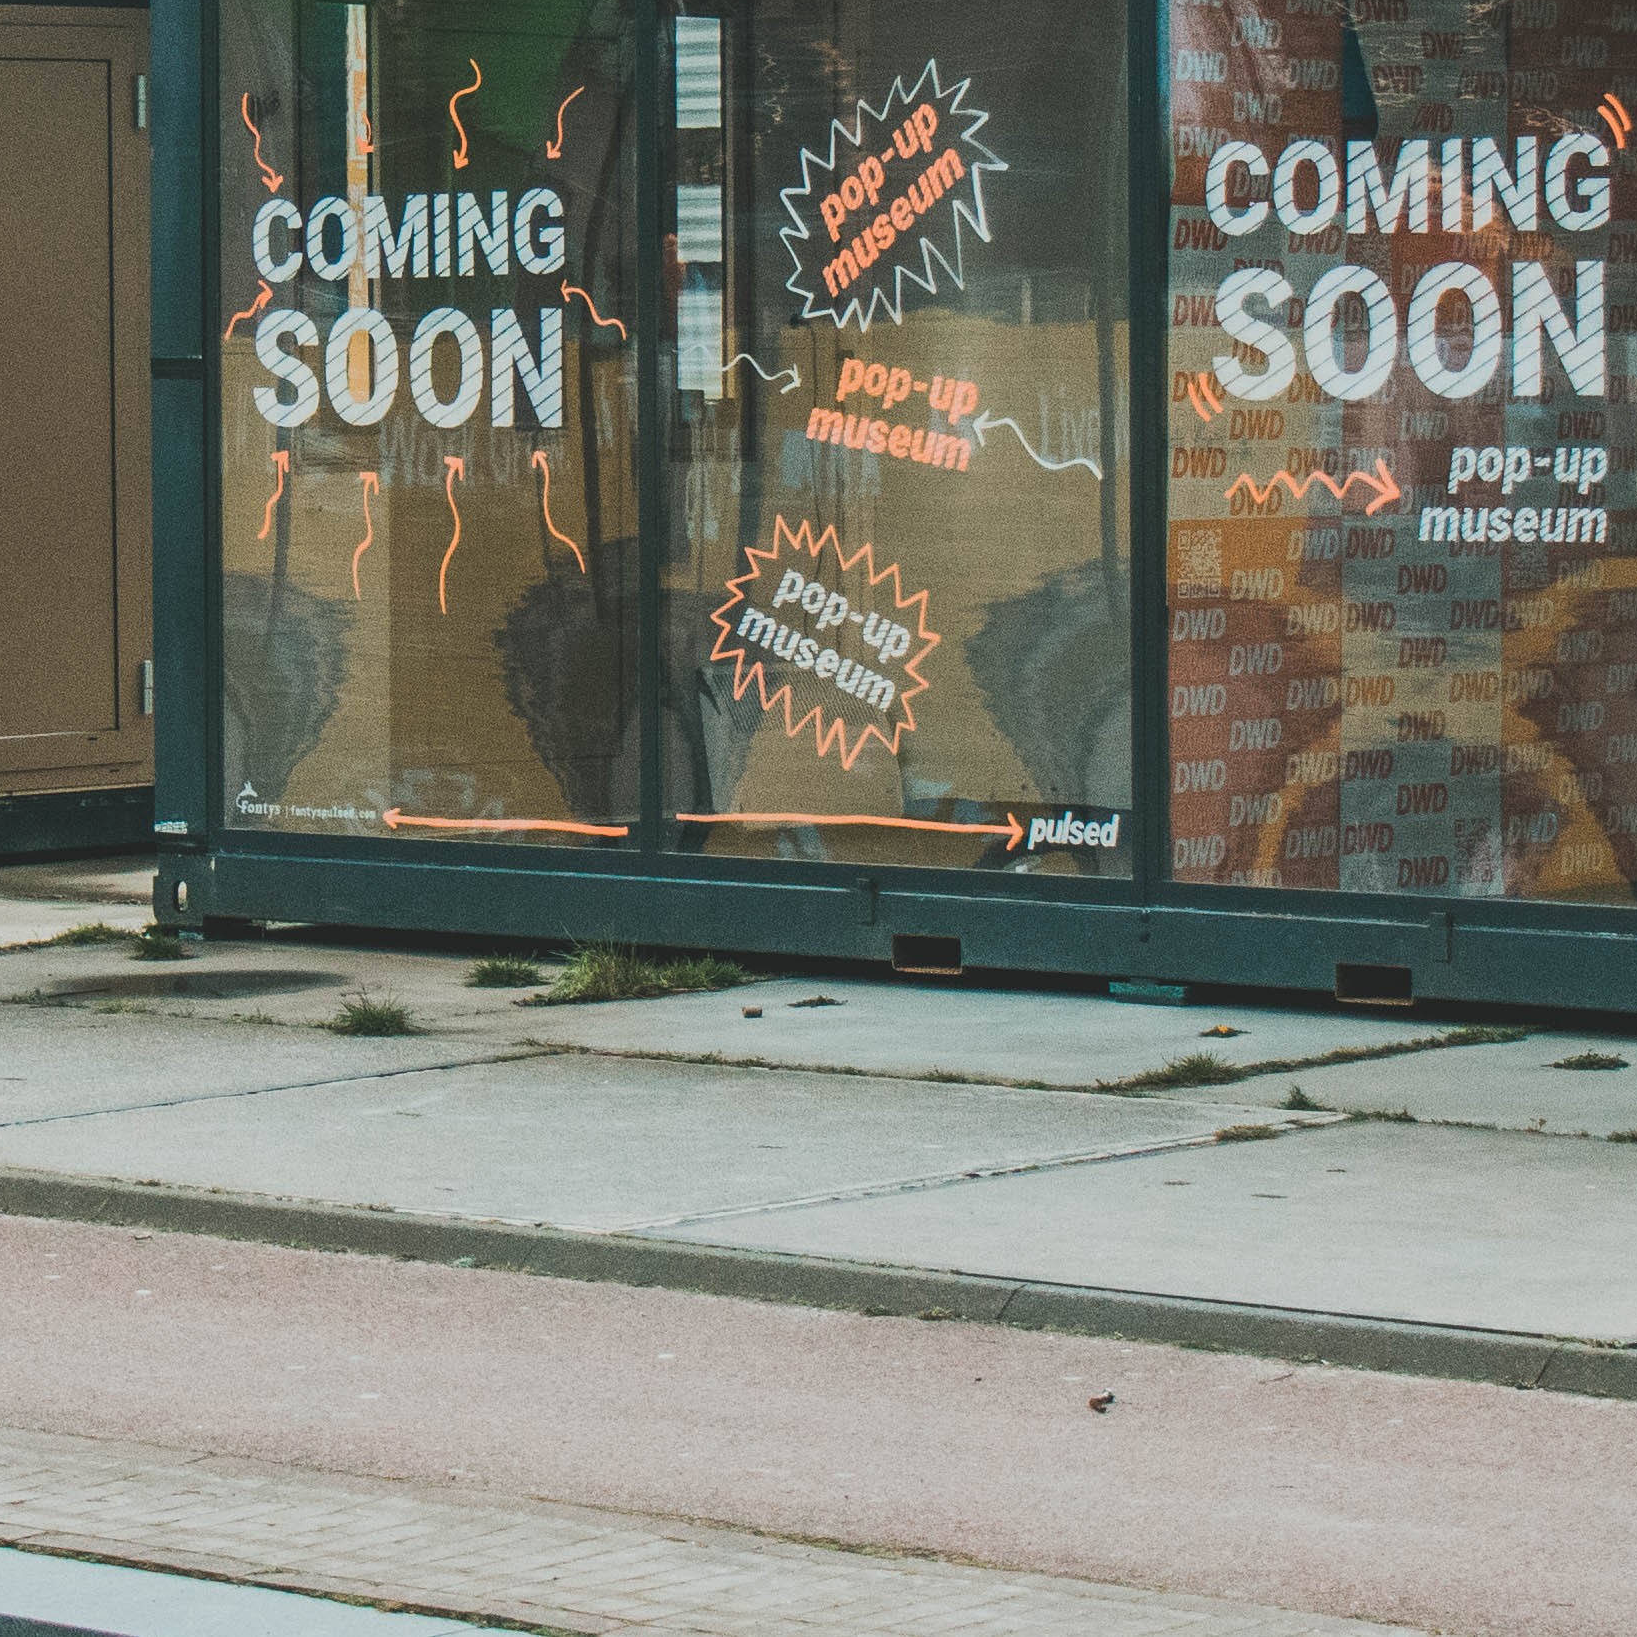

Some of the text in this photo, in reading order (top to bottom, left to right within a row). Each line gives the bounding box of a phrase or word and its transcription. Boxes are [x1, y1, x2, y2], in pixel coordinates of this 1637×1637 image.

[1231, 17, 1284, 50] DWD
[1175, 49, 1229, 83] DWD
[1561, 37, 1608, 67] DWD
[1286, 60, 1340, 91] DWD
[1513, 71, 1560, 101] DWD
[1233, 91, 1284, 125] DWD
[819, 103, 940, 241] pop-up
[1205, 133, 1612, 237] COMING
[1233, 168, 1271, 199] DW
[251, 187, 566, 283] COMING
[819, 146, 968, 299] museum
[1174, 219, 1229, 252] DWD
[1212, 259, 1607, 401] SOON
[253, 306, 566, 430] SOON
[836, 354, 980, 419] pop-up
[806, 407, 972, 473] museum
[1229, 409, 1285, 441] DWD
[1401, 410, 1449, 442] DWD
[1556, 411, 1607, 440] DWD
[1172, 448, 1227, 479] DWD
[1287, 447, 1340, 477] DWD
[1447, 444, 1608, 496] pop-up
[1230, 484, 1283, 515] DWD
[1417, 502, 1608, 546] museum
[1286, 528, 1341, 561] DWD
[1345, 527, 1396, 560] DWD
[1231, 569, 1285, 601] DWD
[1396, 563, 1449, 595] DWD
[1556, 559, 1605, 590] DWD
[772, 567, 912, 661] pop-up
[1172, 609, 1227, 642] DWD
[1286, 603, 1341, 636] DWD
[1345, 602, 1396, 633] DWD
[1450, 600, 1499, 631] DWD
[1505, 598, 1555, 631] DWD
[736, 606, 898, 712] museum
[1229, 642, 1284, 676] DWD
[1397, 637, 1448, 669] DWD
[1556, 630, 1605, 662] DWD
[1172, 684, 1227, 717] DWD
[1286, 678, 1340, 711] DWD
[1345, 675, 1395, 707] DWD
[1449, 671, 1499, 704] DWD
[1506, 668, 1556, 702] DWD
[1396, 711, 1447, 742] DWD
[1556, 700, 1606, 733] DWD
[1229, 718, 1283, 752] DWD
[1285, 751, 1338, 785] DWD
[1345, 749, 1394, 782] DWD
[1450, 744, 1499, 777] DWD
[1506, 741, 1555, 774] DWD
[1174, 759, 1227, 794] DWD
[1556, 771, 1604, 805] DWD
[239, 800, 282, 819] Fontys
[1229, 792, 1285, 827] DWD
[1395, 783, 1449, 816] DWD
[1026, 810, 1121, 851] pulsed
[1285, 825, 1338, 860] DWD
[1343, 822, 1394, 855] DWD
[1506, 811, 1558, 845] DWD
[1174, 835, 1226, 870] DWD
[1560, 842, 1606, 876] DWD
[1397, 855, 1450, 888] DWD
